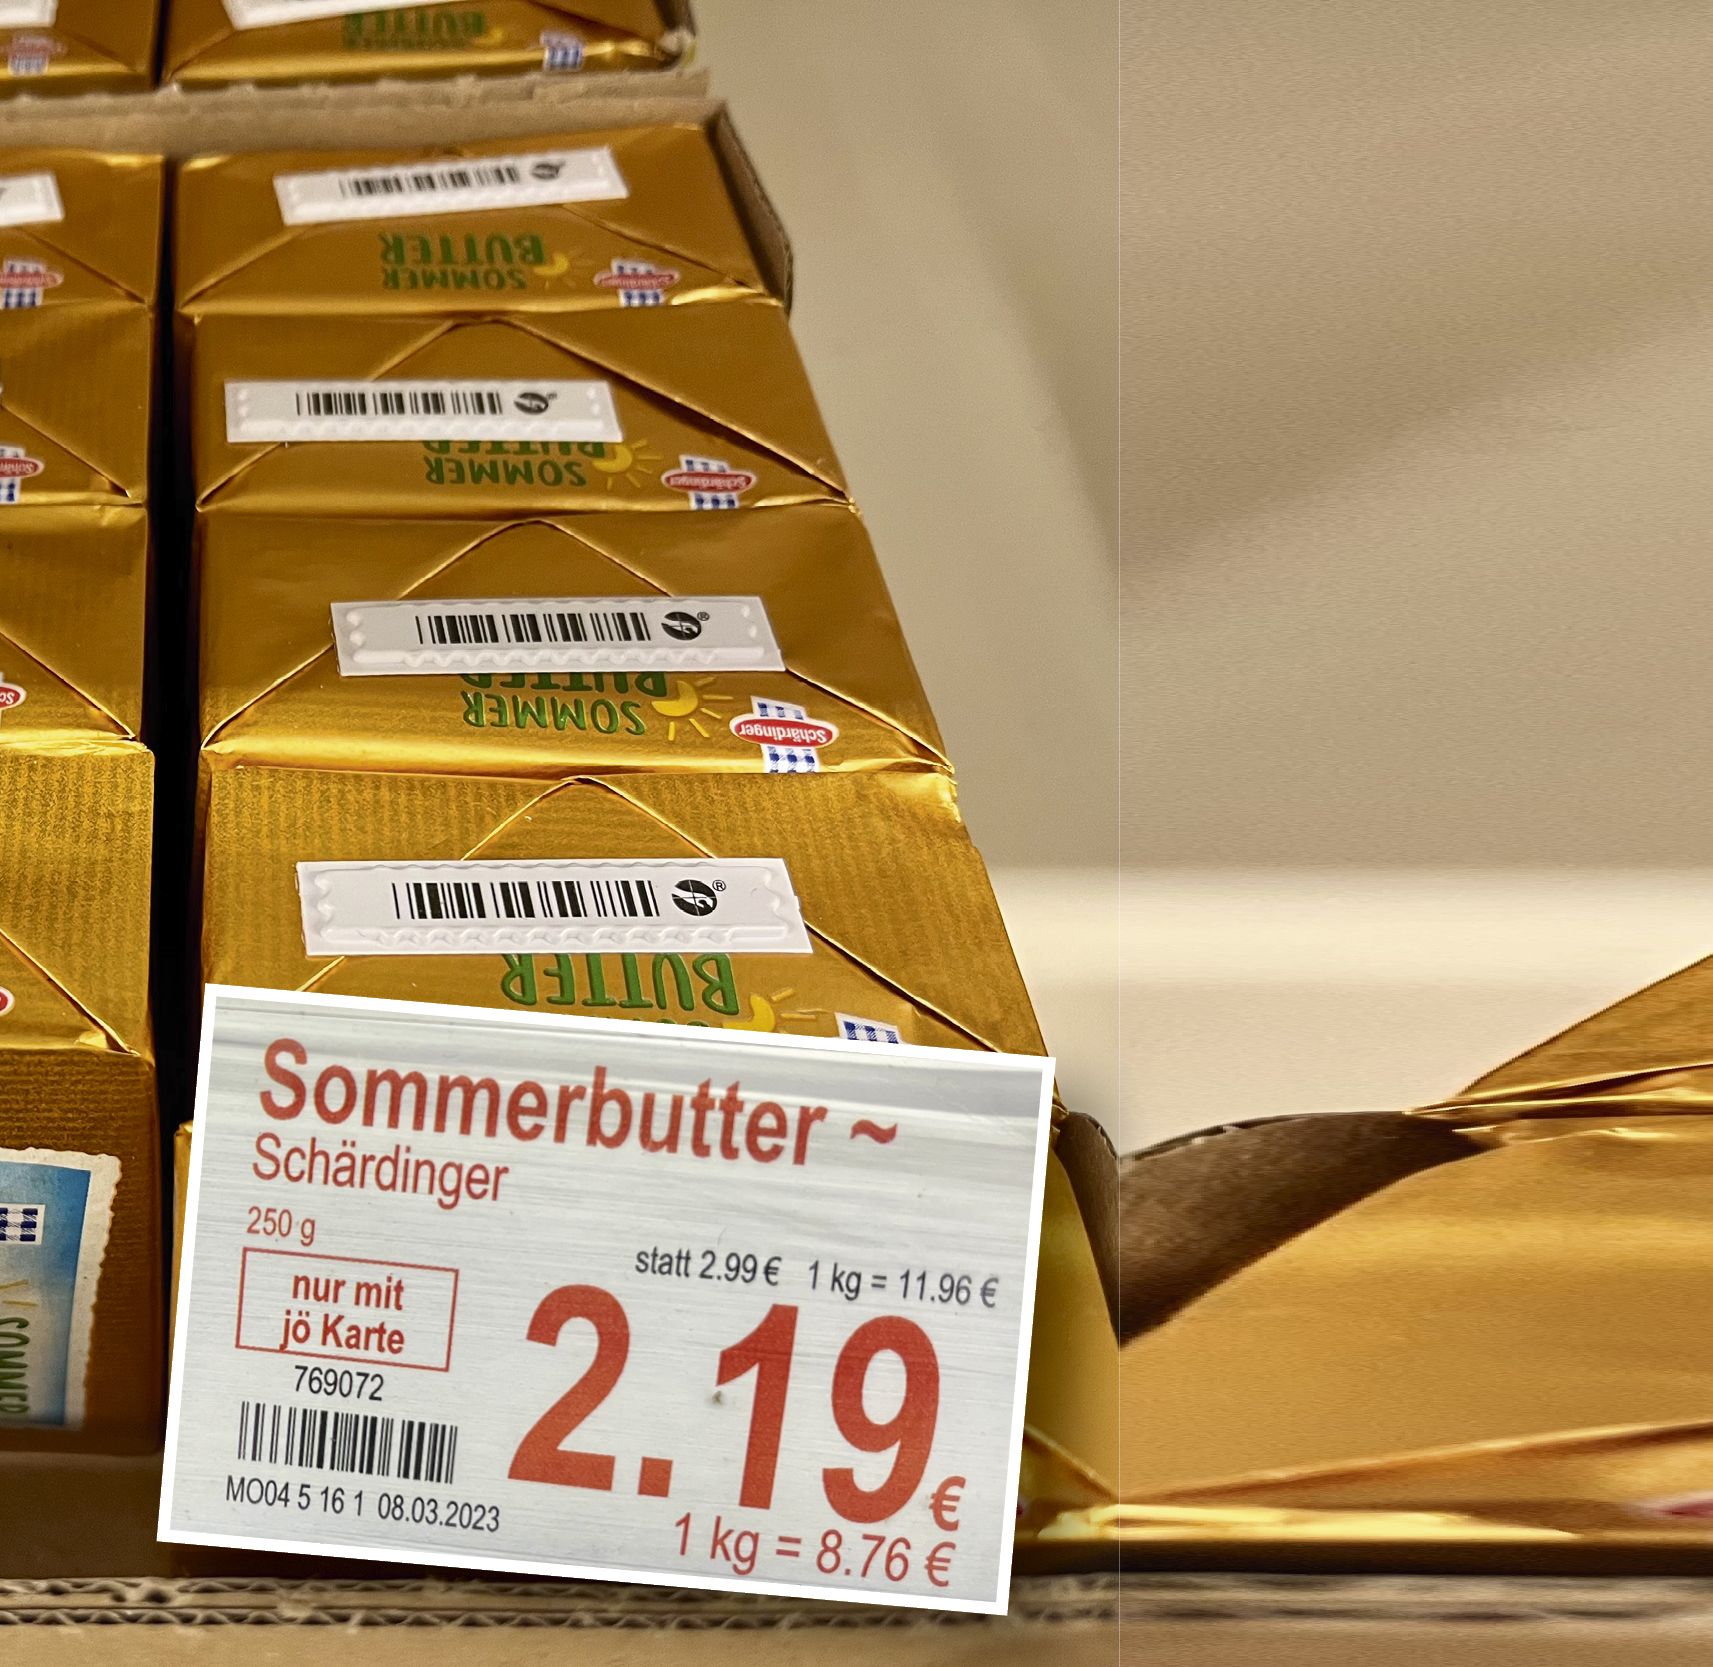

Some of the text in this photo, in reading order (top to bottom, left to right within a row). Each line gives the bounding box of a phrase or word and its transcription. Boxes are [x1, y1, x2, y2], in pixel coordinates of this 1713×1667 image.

[378, 232, 545, 265] BUTTER
[423, 455, 587, 486] SOMMER
[461, 689, 647, 736] SOMMER
[739, 722, 828, 745] Schärdinger
[501, 953, 740, 1016] BUTTER
[258, 1038, 829, 1167] Sommerbutter
[252, 1132, 510, 1212] Schärdinger
[247, 1206, 316, 1247] 250 g
[292, 1275, 404, 1311] nur mit
[635, 1246, 999, 1308] statt 2.99 € 1 kg = 11.96 €
[280, 1311, 405, 1355] jö Karte
[294, 1364, 384, 1402] 769072
[507, 1284, 966, 1532] 2.19 €
[297, 1483, 311, 1511] 5
[320, 1486, 345, 1514] 16
[353, 1490, 364, 1516] 1
[377, 1492, 500, 1533] 08.03.2023
[675, 1514, 956, 1587] 1 kg = 8.76 €
